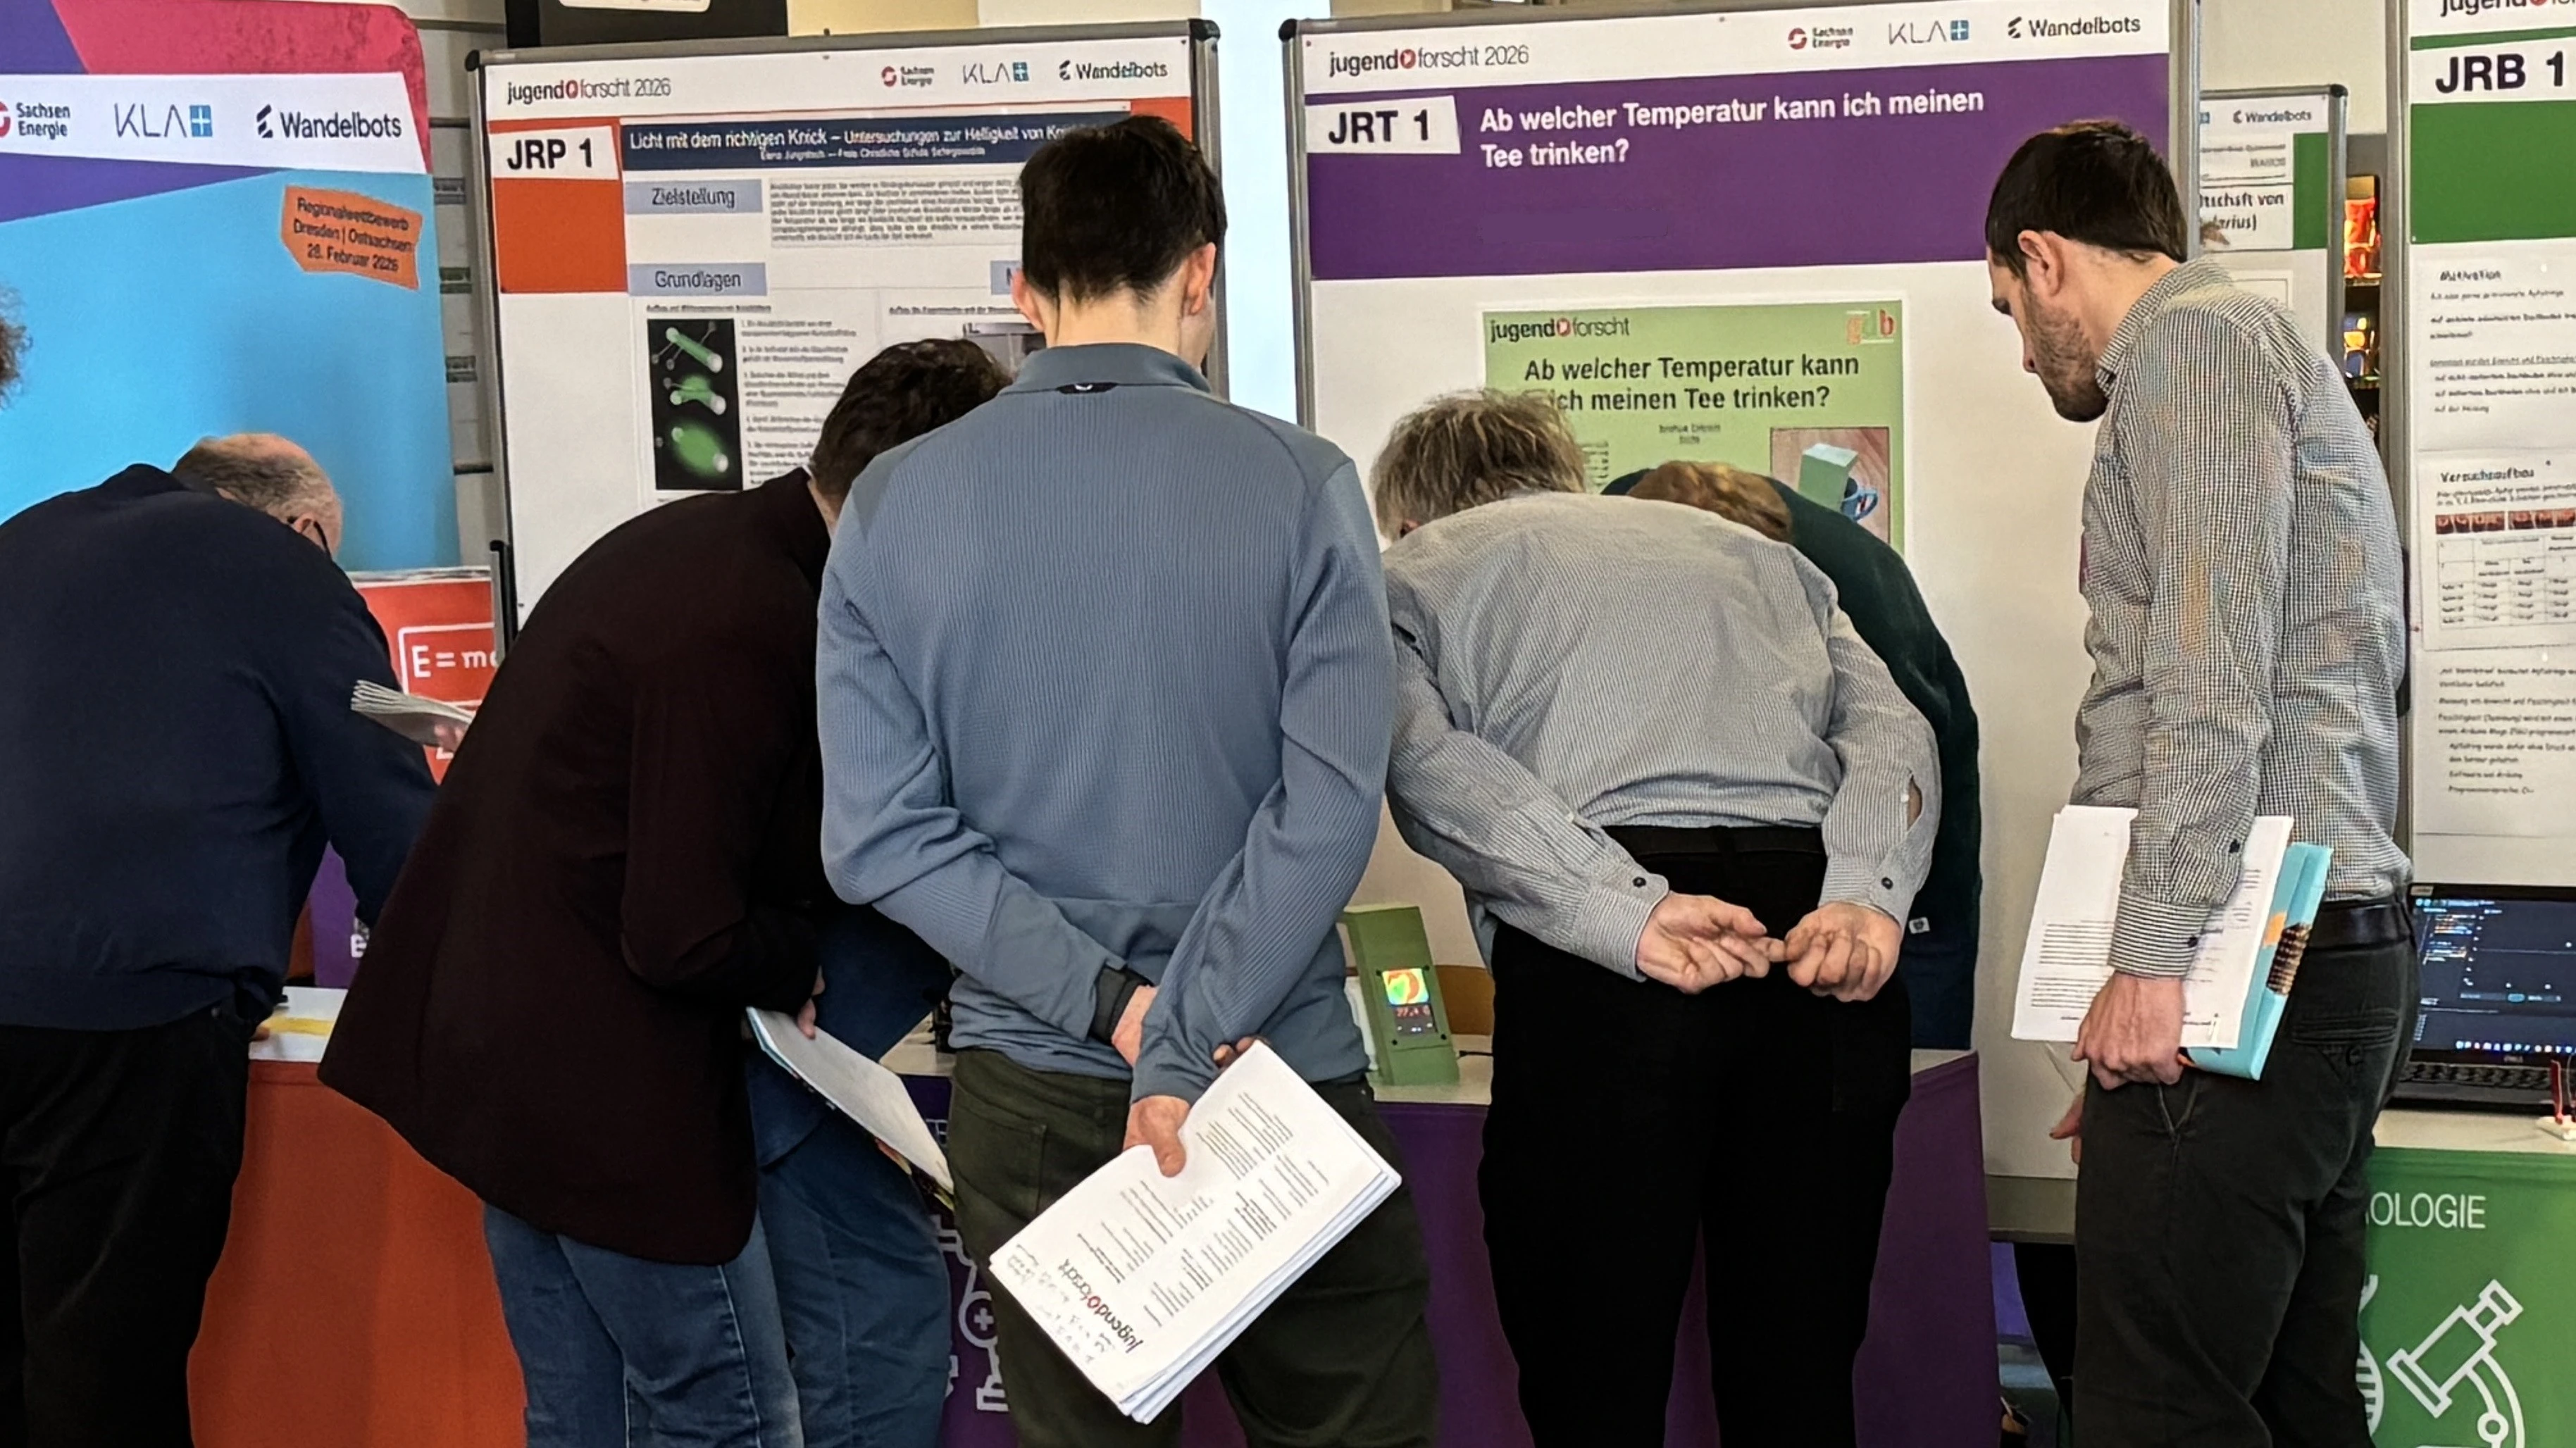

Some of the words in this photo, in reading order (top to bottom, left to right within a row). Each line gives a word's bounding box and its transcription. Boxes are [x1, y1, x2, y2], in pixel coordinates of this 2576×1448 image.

[1889, 20, 1947, 44] KLA
[2029, 16, 2141, 37] Wandelbots
[1329, 49, 1398, 77] jugend
[1418, 46, 1479, 68] forscht
[1484, 45, 1529, 65] 2026
[2435, 54, 2526, 94] JRB
[2546, 51, 2563, 87] 1
[507, 80, 564, 105] jugend
[580, 77, 630, 99] forscht
[635, 77, 671, 97] 2026
[16, 102, 70, 118] Sachsen
[113, 103, 187, 138] KLA
[1479, 108, 1513, 132] Ab
[1519, 105, 1617, 130] welcher
[1622, 99, 1767, 130] Temperatur
[1774, 96, 1835, 120] kann
[1843, 91, 1881, 118] ich
[1889, 88, 1984, 115] meinen
[18, 120, 68, 140] Energie
[280, 111, 402, 138] Wandelbots
[1329, 110, 1398, 144] JRT
[1414, 109, 1429, 141] 1
[506, 139, 566, 170] JRP
[579, 137, 592, 168] 1
[630, 132, 663, 149] Licht
[691, 132, 721, 147] dem
[1480, 143, 1523, 168] Tee
[1529, 137, 1629, 166] trinken?
[652, 187, 735, 208] Zielstellung
[655, 270, 741, 292] Grundlagen
[1491, 319, 1555, 343] jugend
[1573, 317, 1629, 337] forscht
[1524, 358, 1555, 381] Ab
[1562, 357, 1651, 380] welcher
[1657, 356, 1793, 382] Temperatur
[1801, 354, 1859, 375] kann
[1550, 389, 1583, 411] ich
[1591, 388, 1676, 411] meinen
[1684, 387, 1725, 409] Tee
[1734, 385, 1830, 408] trinken?
